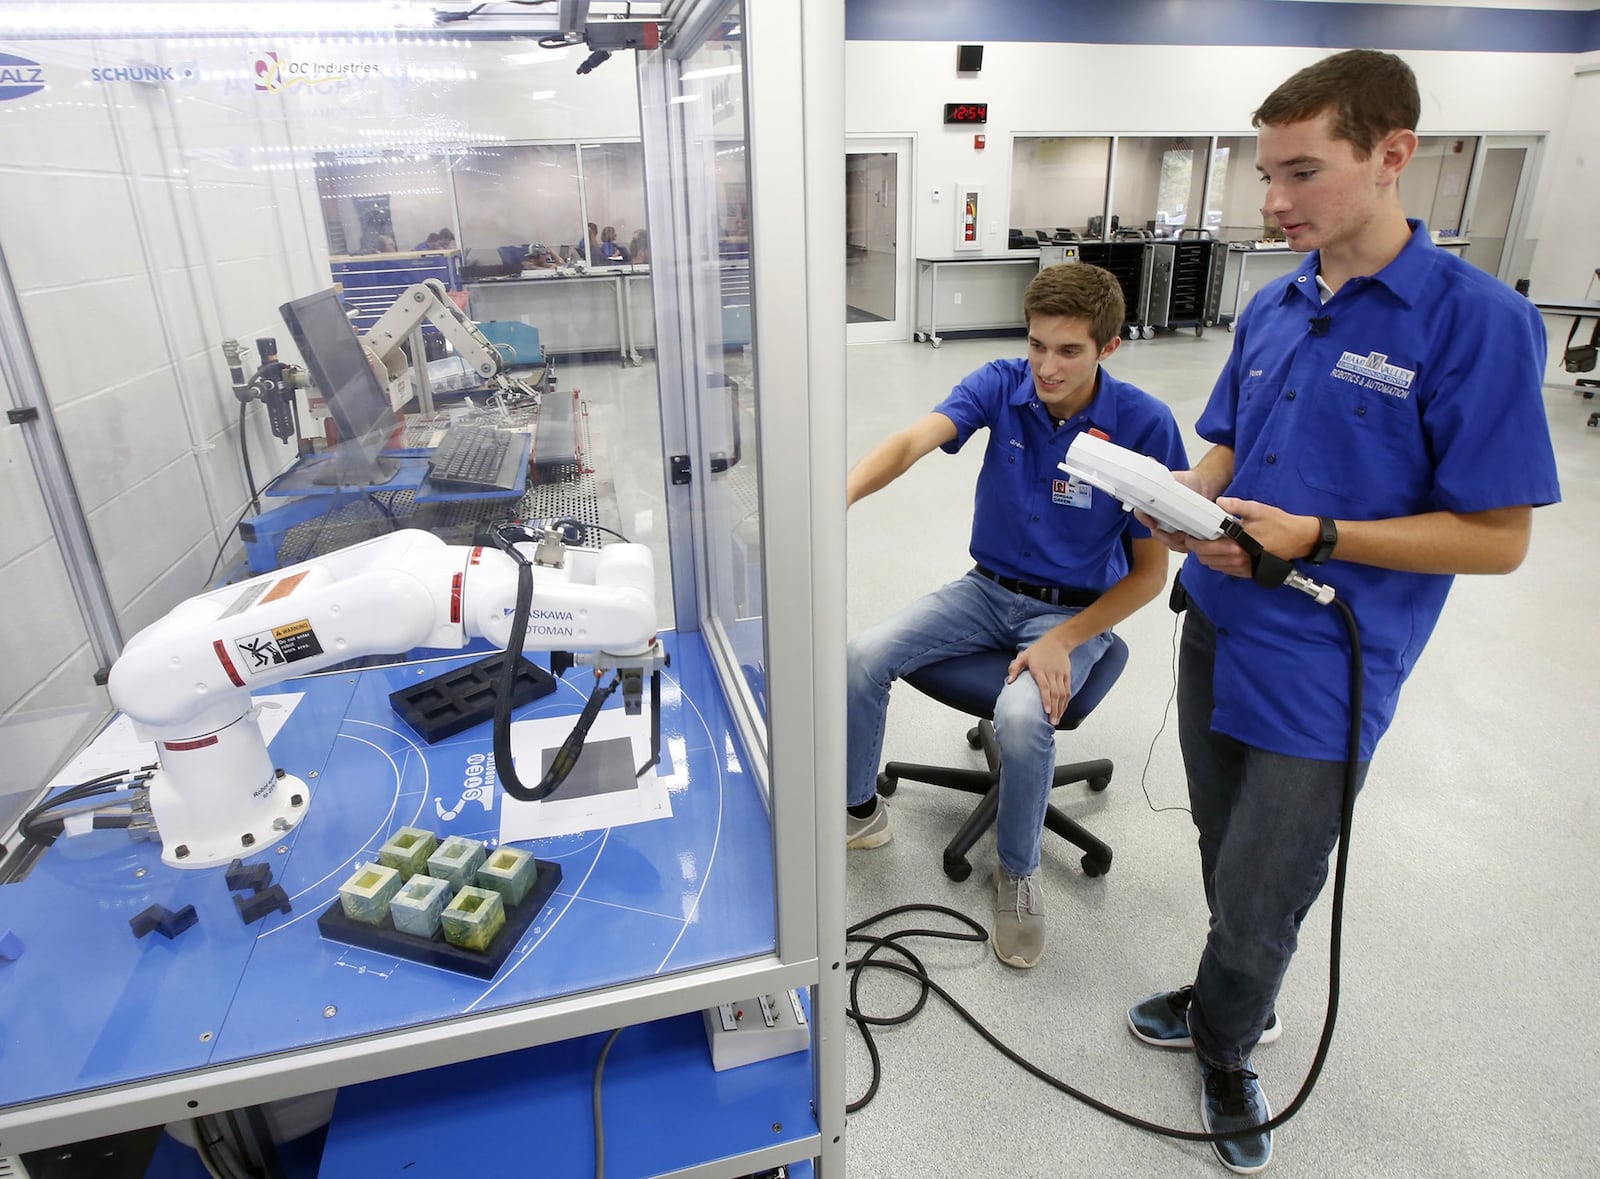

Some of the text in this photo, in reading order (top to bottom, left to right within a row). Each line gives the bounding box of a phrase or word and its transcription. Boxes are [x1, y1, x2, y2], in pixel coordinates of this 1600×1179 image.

[91, 67, 175, 82] SCHUNK
[313, 62, 379, 73] Industries
[0, 69, 45, 83] ALZ
[953, 106, 986, 120] 12:54
[1381, 365, 1412, 379] VALLEY
[1330, 369, 1359, 385] ROBOTICS
[1365, 379, 1410, 400] AUTOMATION
[529, 609, 573, 621] ASKAWA
[526, 625, 573, 636] OTOMAN
[484, 751, 496, 785] ROBOTICS
[463, 754, 485, 800] STEM
